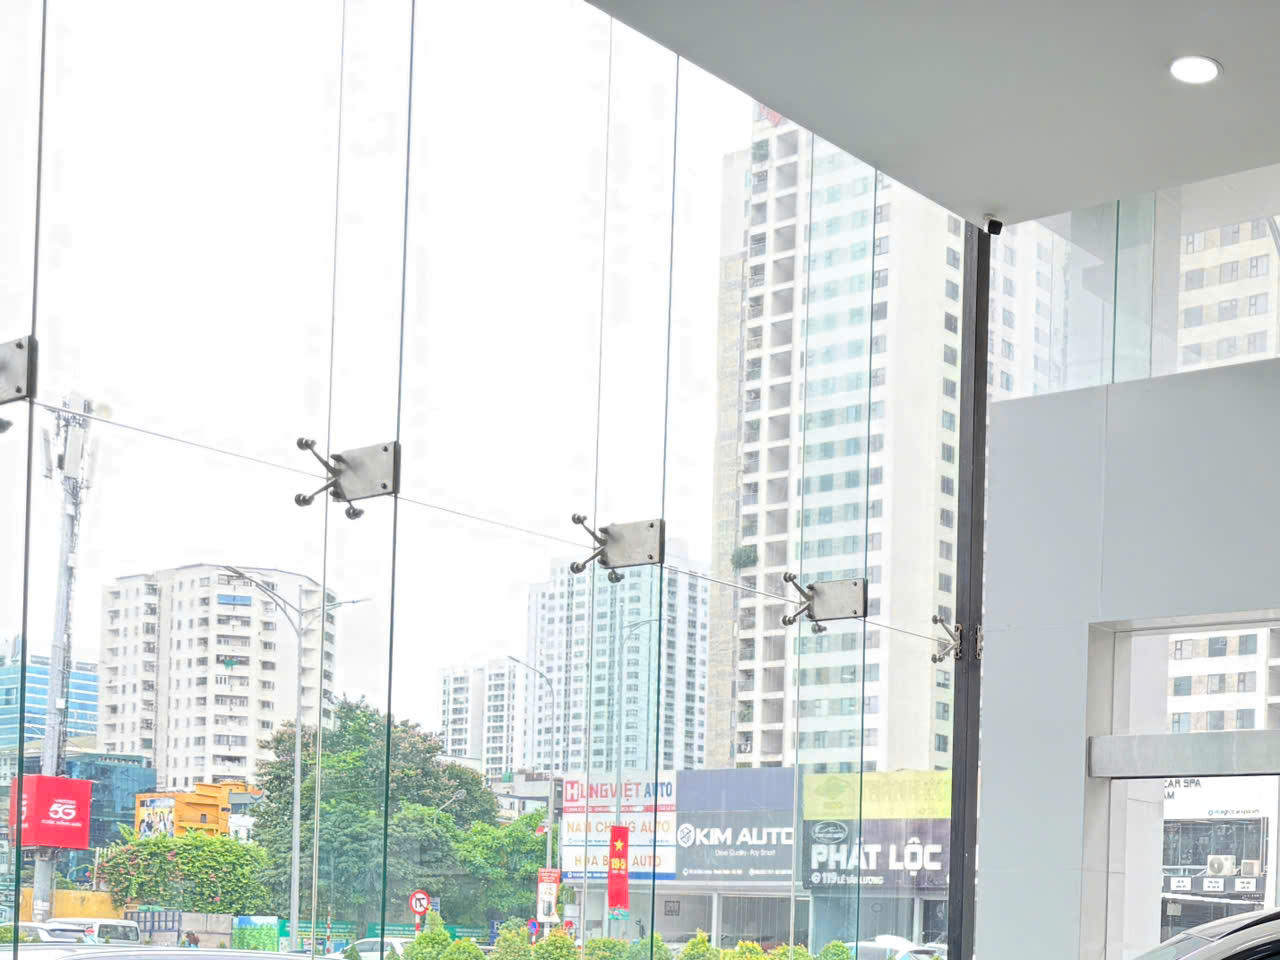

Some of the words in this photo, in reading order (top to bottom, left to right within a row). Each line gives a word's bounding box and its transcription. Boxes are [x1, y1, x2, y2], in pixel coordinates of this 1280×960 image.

[1183, 778, 1201, 788] SPA
[48, 803, 76, 820] 5G
[695, 827, 733, 846] KIM
[811, 837, 882, 870] PHÁT
[888, 836, 943, 877] LỘC
